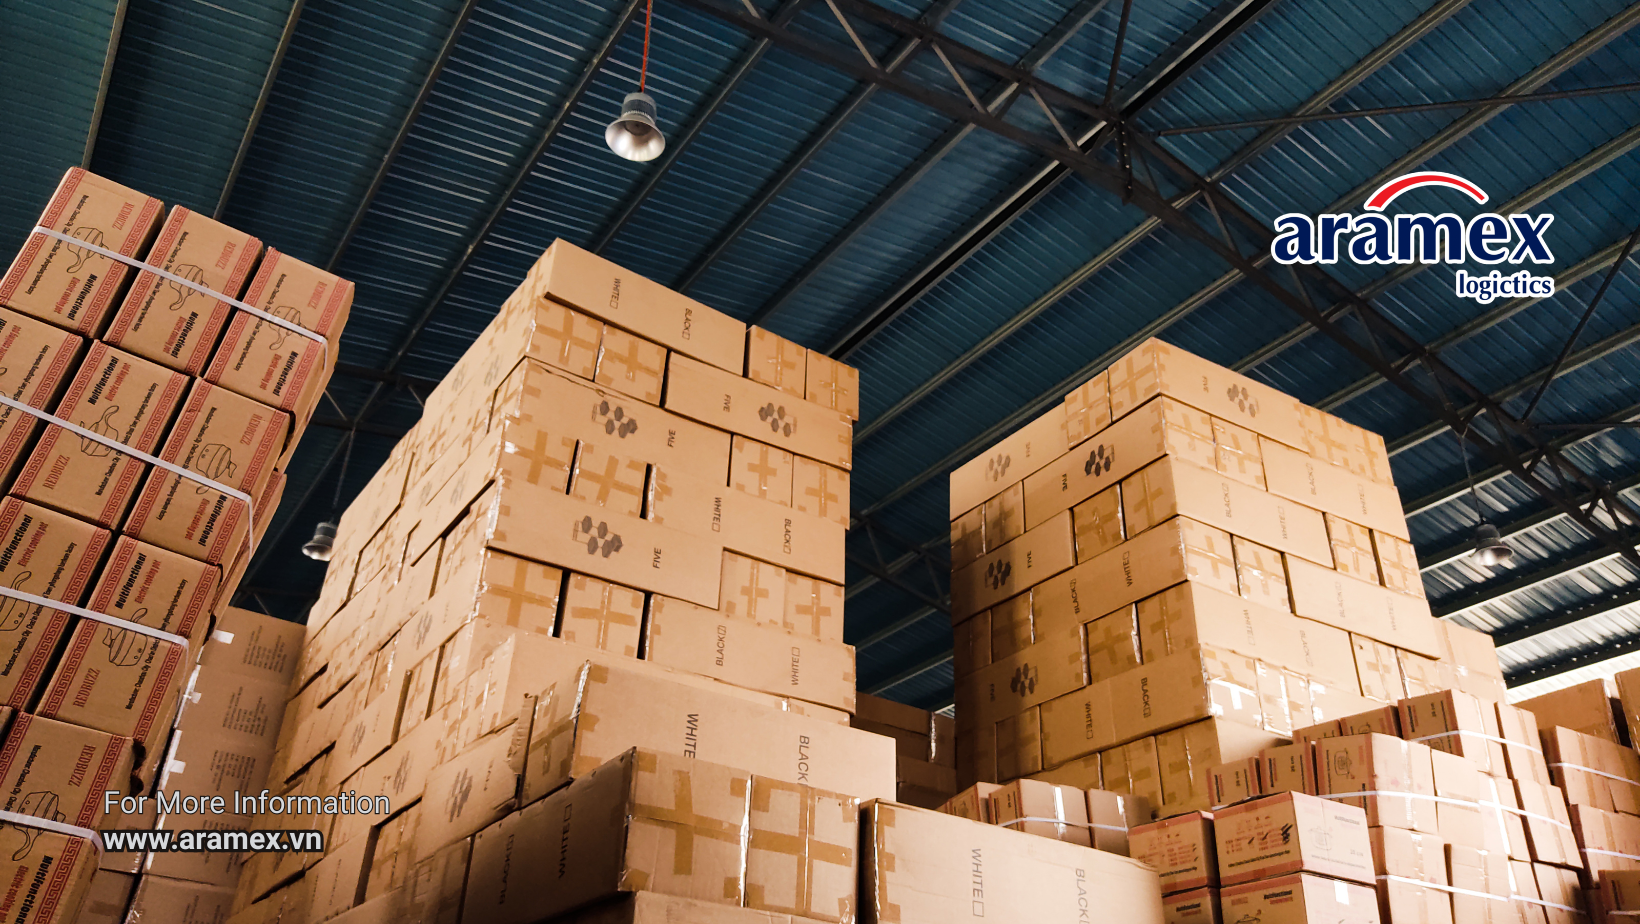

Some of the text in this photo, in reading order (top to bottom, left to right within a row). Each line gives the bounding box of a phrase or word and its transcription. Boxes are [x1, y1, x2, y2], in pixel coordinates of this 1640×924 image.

[112, 202, 134, 230] REDBUZZ
[68, 274, 97, 320] Multifunctional
[612, 278, 621, 301] WHITE
[171, 312, 198, 358] Multifunctional
[683, 308, 692, 330] BLACK
[88, 356, 118, 404] Multifunctional
[273, 352, 298, 395] Multifunctional
[723, 394, 731, 412] FIVE
[240, 414, 262, 445] REDBUZZ
[667, 429, 676, 447] FIVE
[43, 455, 69, 489] REDBUZZ
[199, 495, 226, 546] Multifunctional
[713, 497, 722, 522] WHITE
[1222, 490, 1231, 518] BLACK
[783, 518, 792, 545] BLACK
[653, 547, 661, 569] FIVE
[1123, 559, 1133, 587] WHITE
[115, 553, 145, 608] Multifunctional
[1071, 586, 1080, 614] BLACK
[716, 635, 725, 666] BLACK
[73, 668, 99, 707] REDBUZZ
[791, 656, 799, 686] WHITE
[1141, 677, 1150, 710] BLACK
[684, 713, 699, 759] WHITE
[68, 745, 95, 786] REDBUZZ
[797, 735, 810, 782] BLACK
[559, 823, 570, 879] WHITE
[14, 855, 53, 924] Multifunctiona
[971, 848, 984, 899] WHITE
[1075, 868, 1089, 919] BLACK
